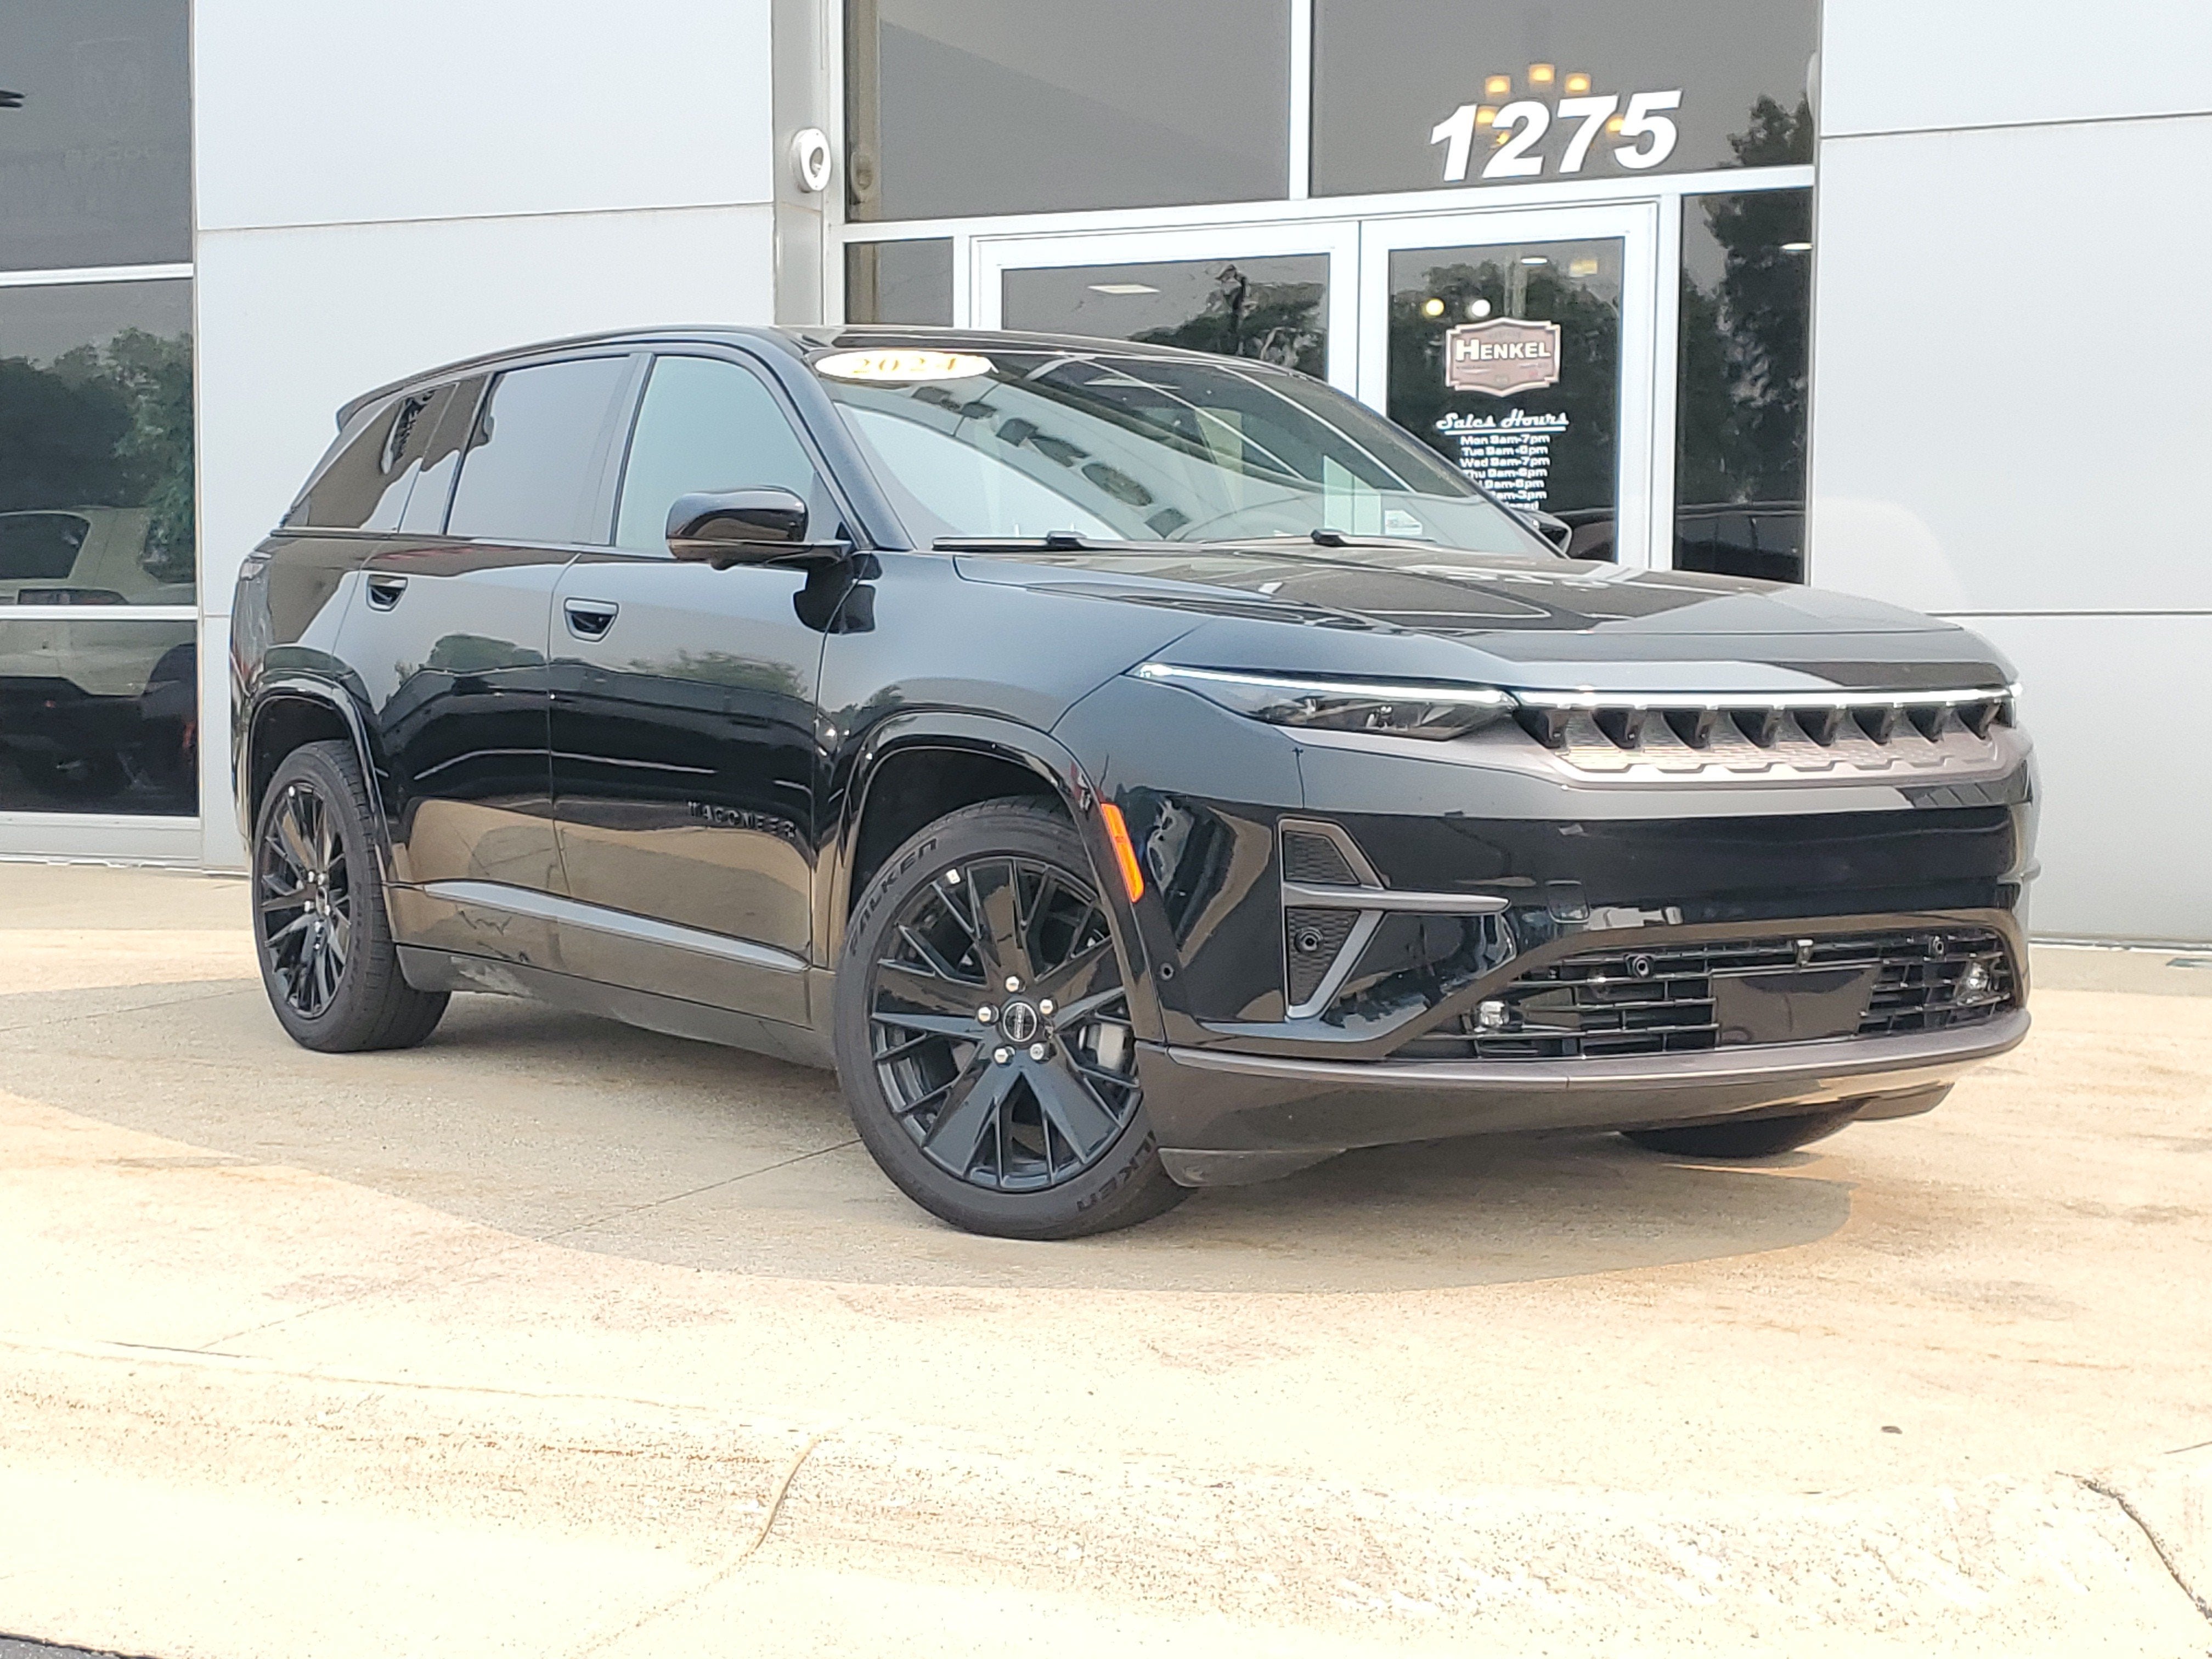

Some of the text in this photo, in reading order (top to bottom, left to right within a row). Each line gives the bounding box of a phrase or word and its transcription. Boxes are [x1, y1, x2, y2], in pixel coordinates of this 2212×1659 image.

[1430, 88, 1683, 182] 1275
[1455, 338, 1551, 362] HENKEL
[851, 357, 958, 374] 2024
[1436, 408, 1569, 430] Sales Hours
[1460, 435, 1488, 445] Mon
[1461, 447, 1485, 456] Tue
[1459, 458, 1488, 467] Wed
[1490, 490, 1547, 501] am-3pm
[850, 838, 937, 957] FALKEN
